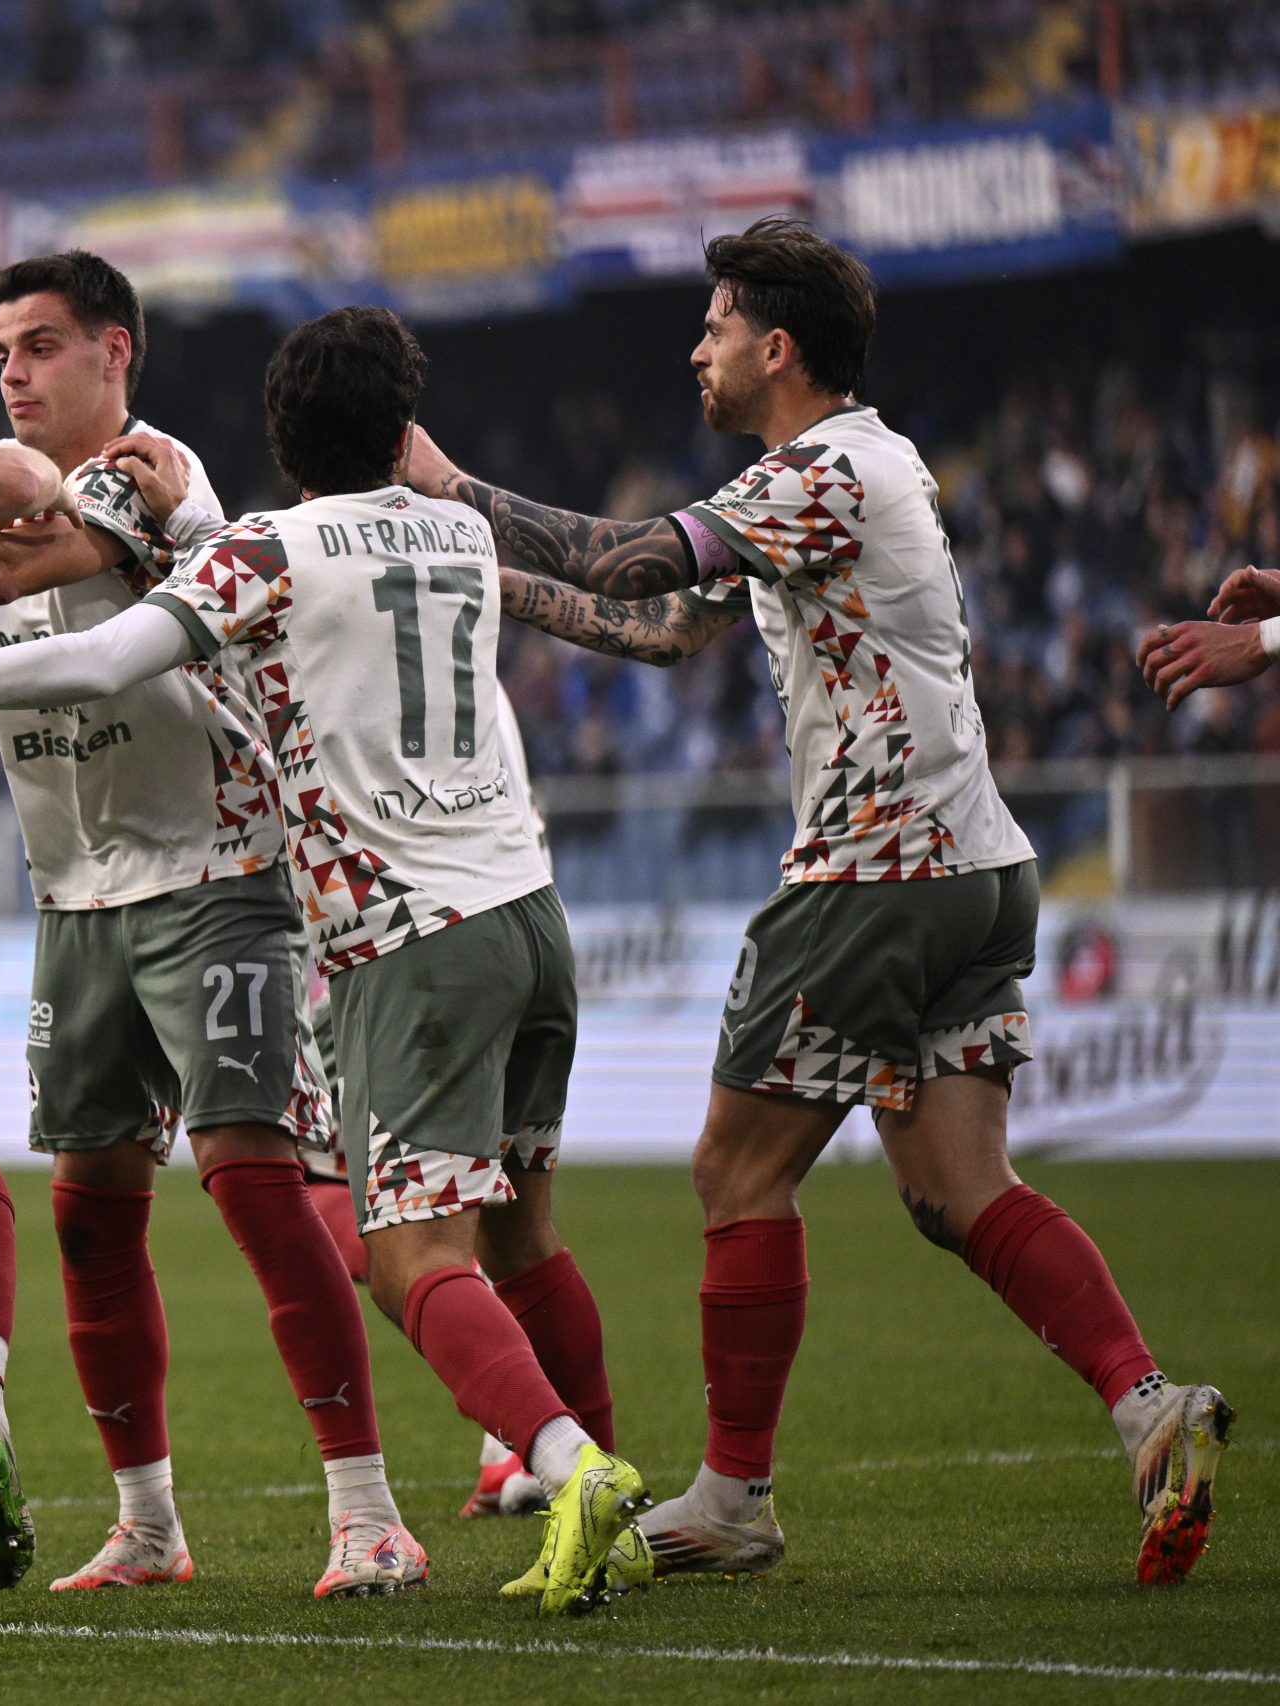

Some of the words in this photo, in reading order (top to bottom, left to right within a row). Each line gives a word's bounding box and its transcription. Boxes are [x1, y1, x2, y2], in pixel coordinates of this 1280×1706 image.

[77, 499, 130, 532] Costruzioni
[317, 523, 352, 558] DI
[372, 565, 485, 759] 17
[12, 721, 132, 762] Bisten
[30, 1000, 53, 1028] 29
[202, 962, 269, 1041] 27
